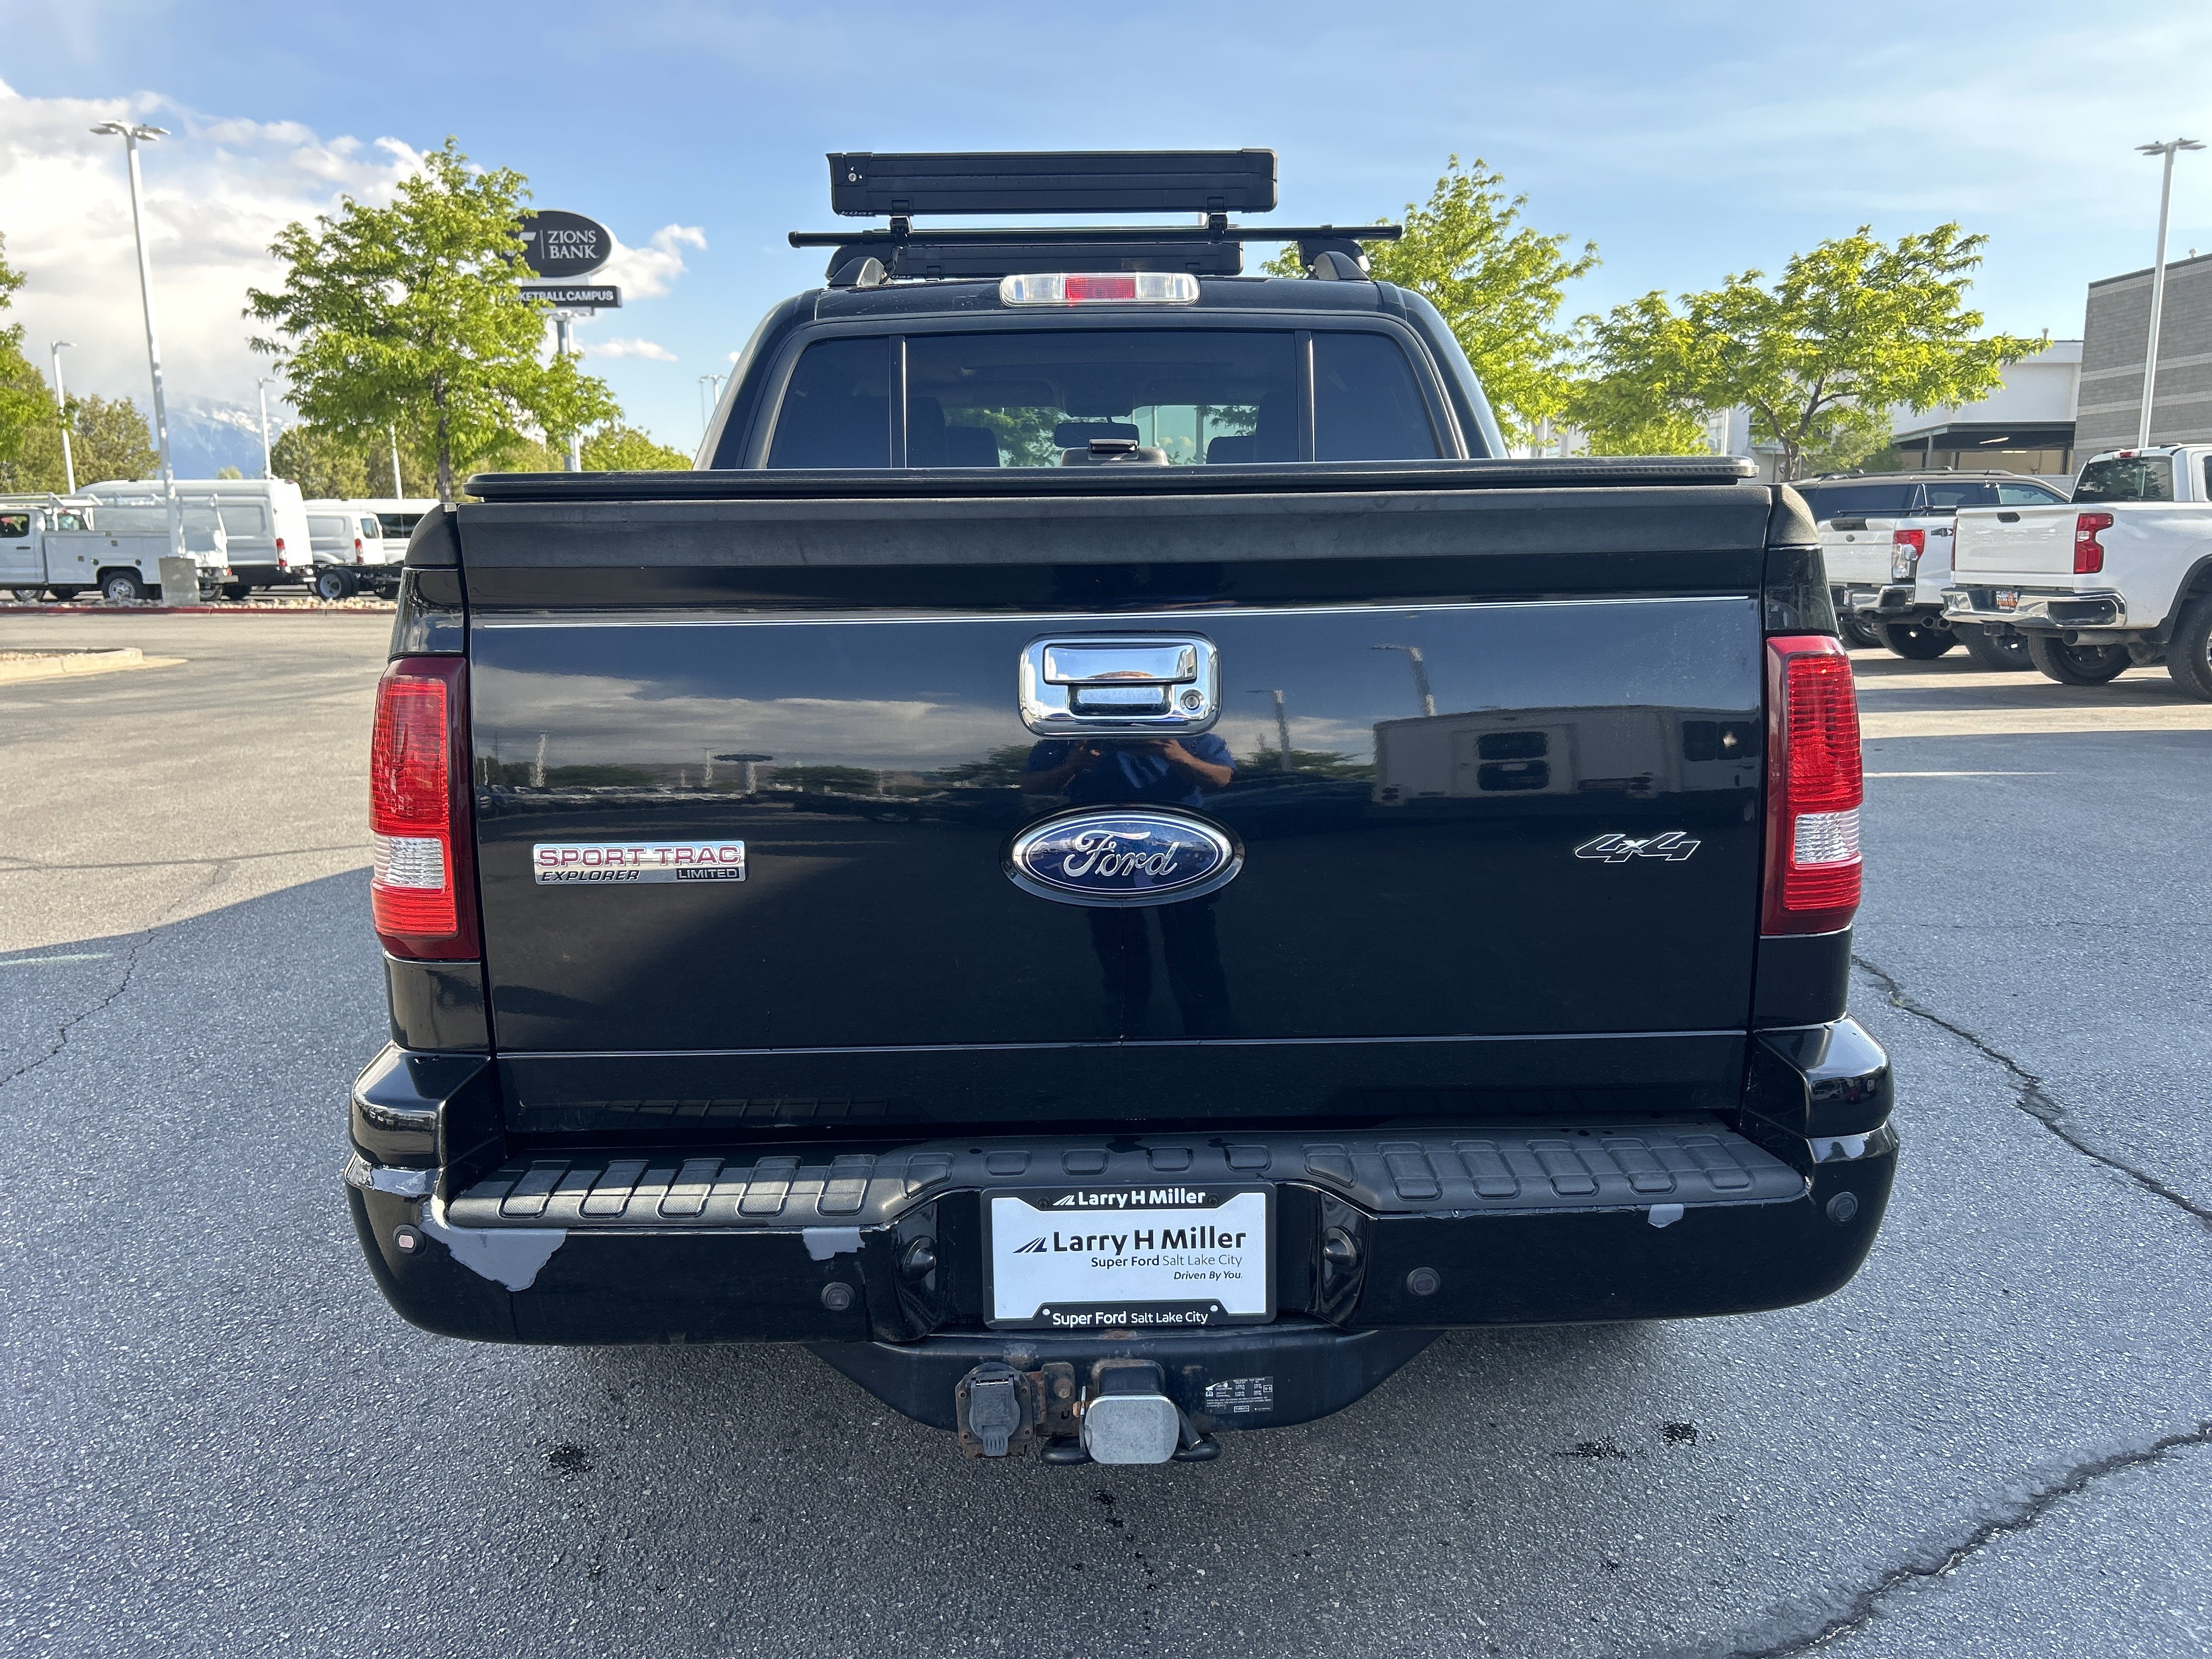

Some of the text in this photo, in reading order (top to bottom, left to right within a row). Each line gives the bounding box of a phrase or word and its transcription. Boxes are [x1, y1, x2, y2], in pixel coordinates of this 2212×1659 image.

[548, 230, 597, 243] ZIONS
[549, 245, 600, 259] BANK
[566, 290, 614, 301] CAMPUS
[1063, 830, 1181, 877] Ford
[1573, 832, 1701, 862] 4x4
[537, 845, 741, 867] SPORT TRAC
[540, 868, 738, 883] EXPLORER LIMITED
[1078, 1187, 1206, 1208] Larry H Miller
[1053, 1225, 1246, 1256] Larry H Miller
[1091, 1254, 1243, 1269] Super Ford Salt Lake City
[1173, 1271, 1206, 1280] Driven
[1209, 1271, 1221, 1281] By
[1052, 1311, 1209, 1328] Super Ford Salt Lake City
